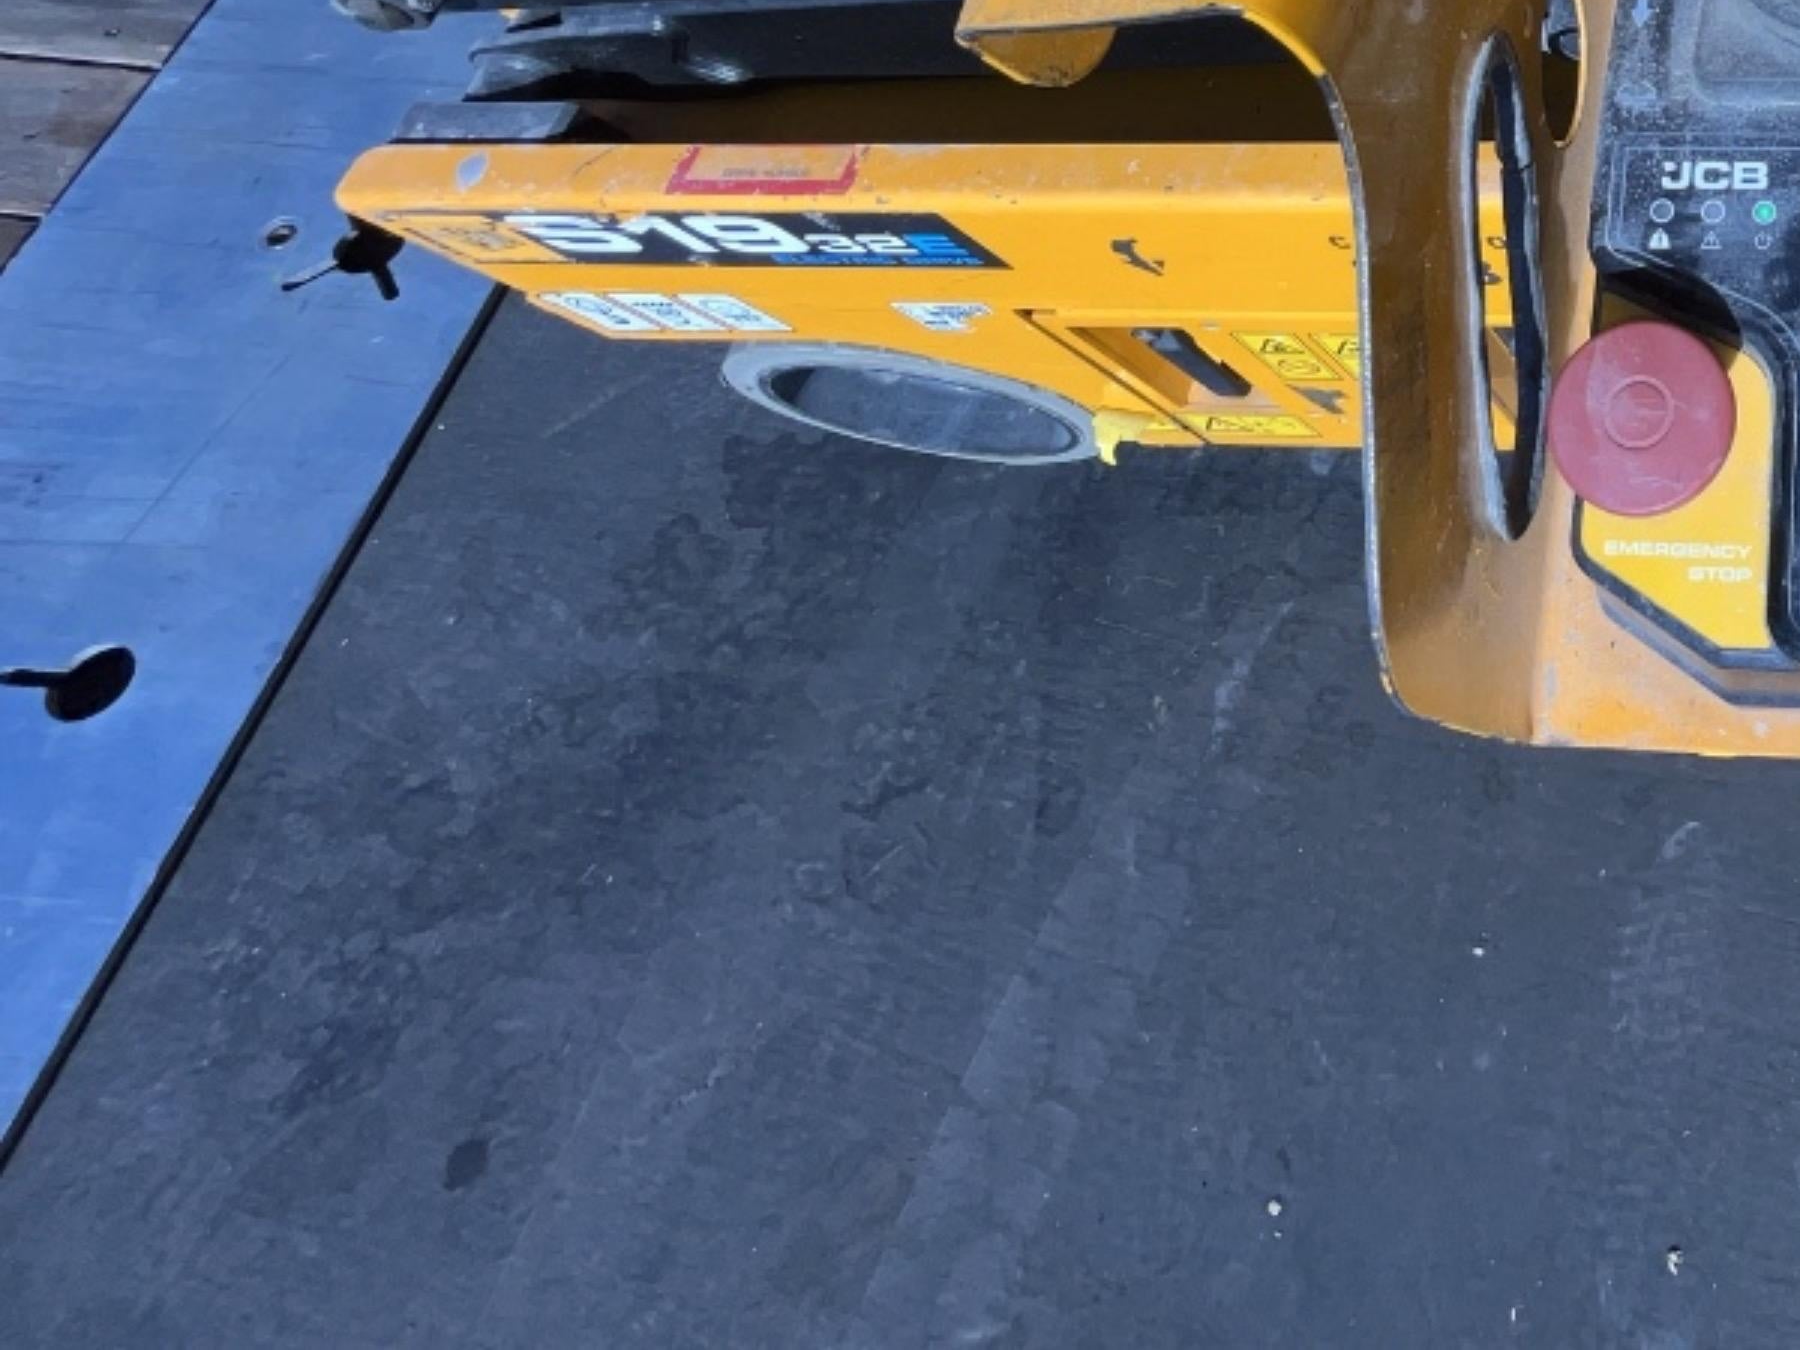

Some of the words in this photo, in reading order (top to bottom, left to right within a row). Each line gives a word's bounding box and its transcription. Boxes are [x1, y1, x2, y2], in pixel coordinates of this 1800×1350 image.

[1661, 161, 1768, 190] JCB
[1604, 539, 1752, 560] EMERGENCY
[1687, 565, 1752, 582] STOP
